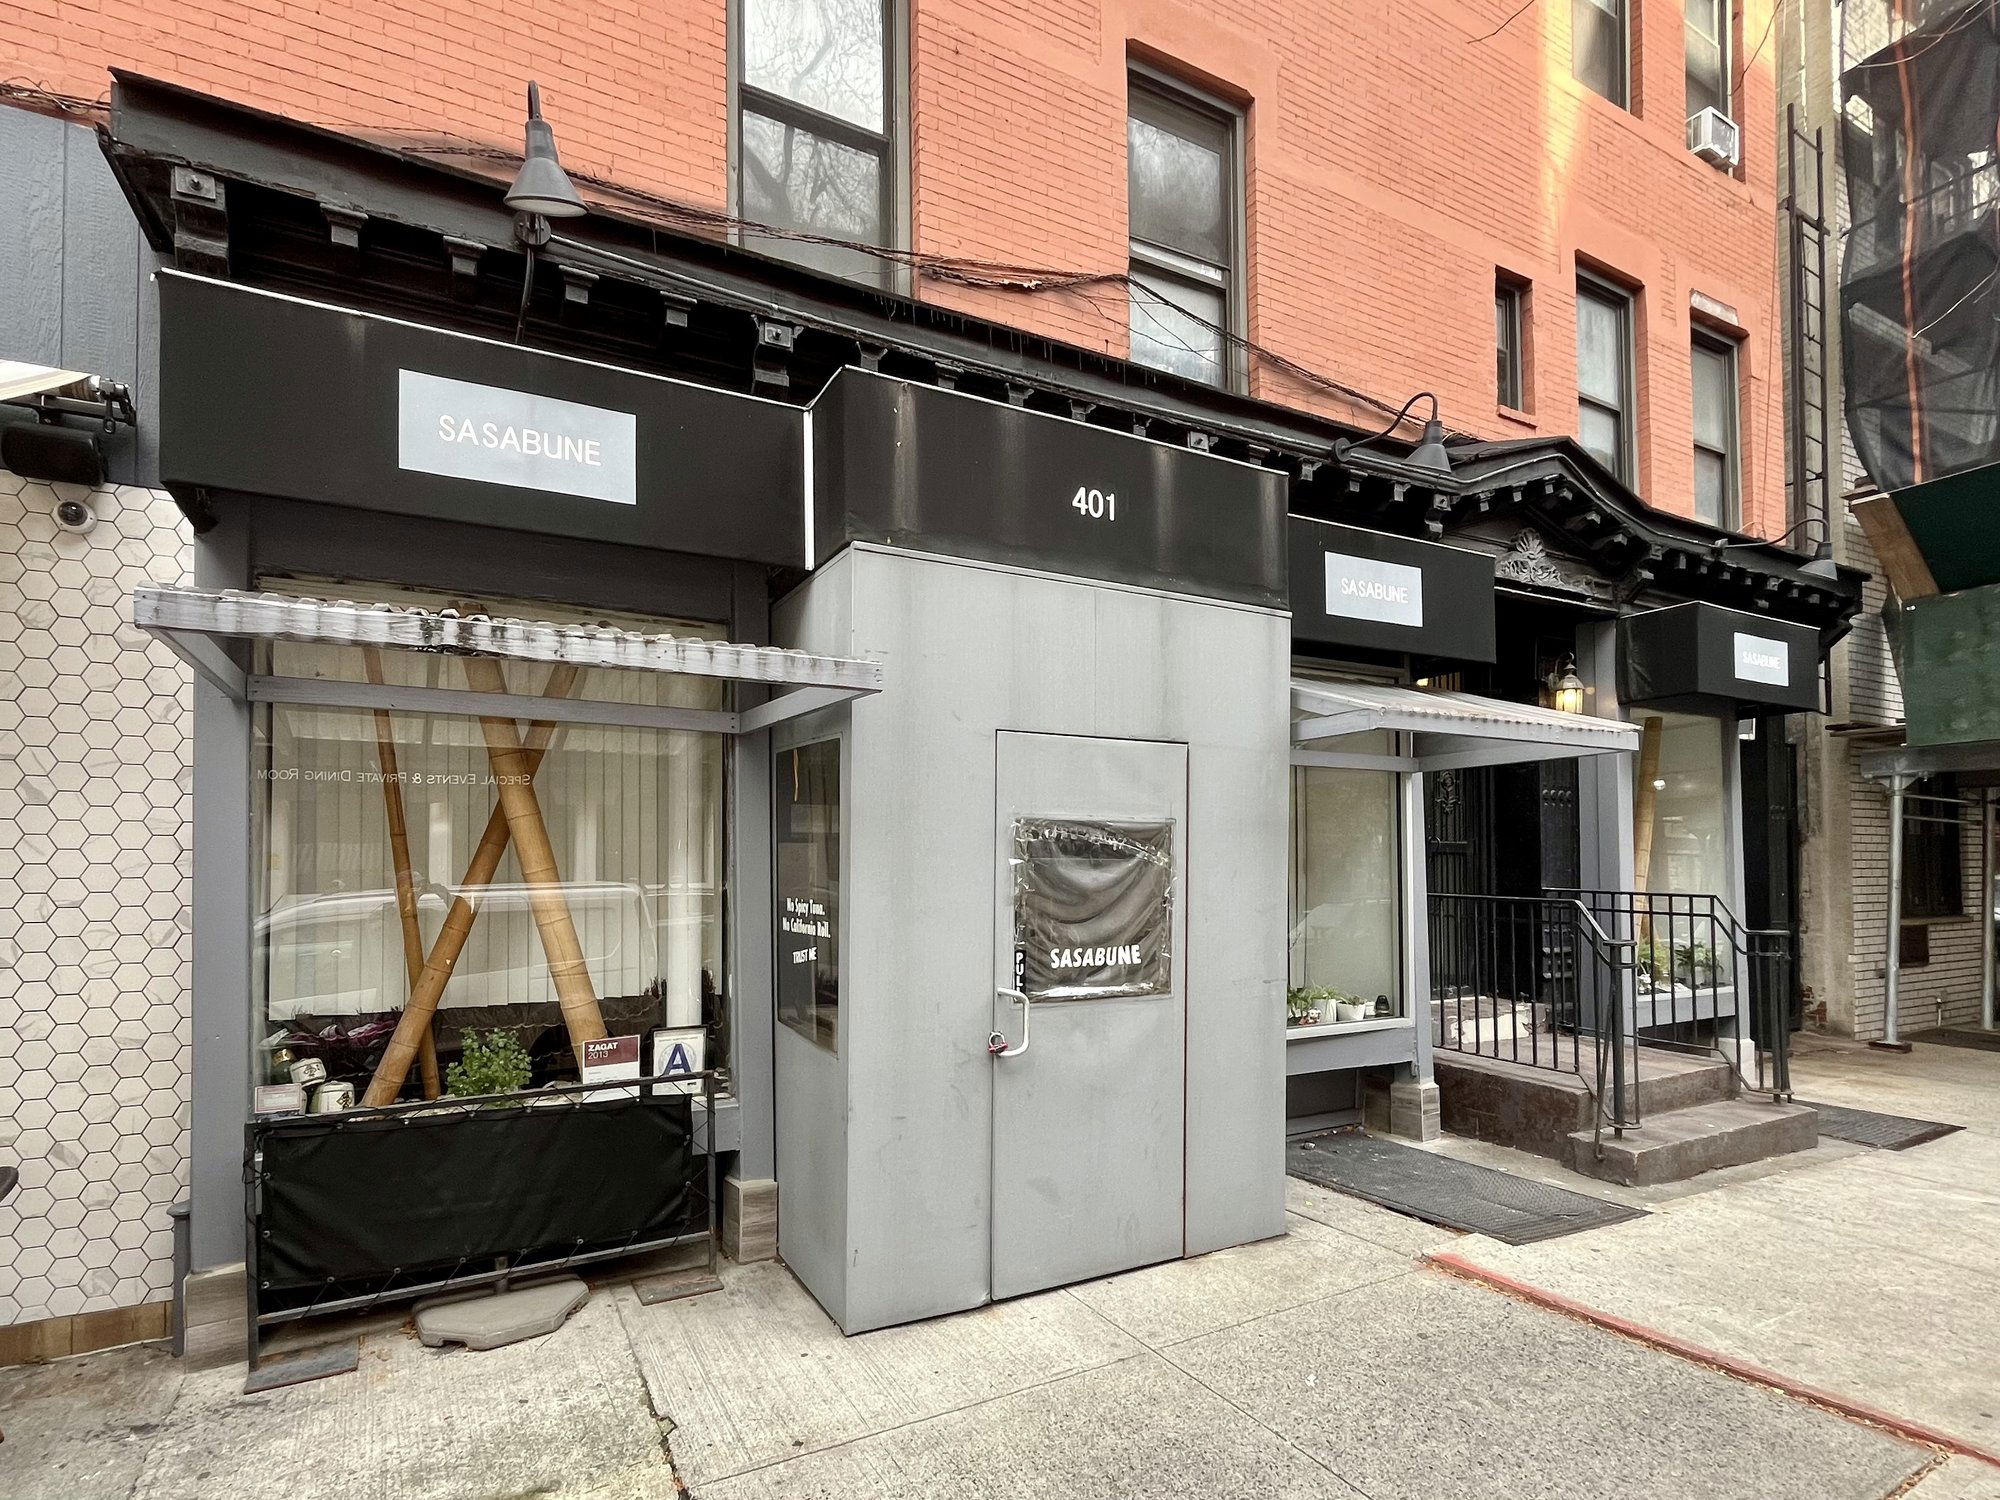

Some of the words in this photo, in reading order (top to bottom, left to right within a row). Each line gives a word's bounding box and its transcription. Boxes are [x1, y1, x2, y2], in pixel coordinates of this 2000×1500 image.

[438, 414, 601, 466] SASABUNE
[1072, 486, 1115, 521] 401
[1341, 577, 1409, 604] SASABUNE
[1742, 651, 1781, 670] SASABUNE
[786, 897, 795, 912] No
[795, 897, 809, 917] Spicy
[809, 899, 826, 916] Tuna.
[782, 916, 790, 931] No
[790, 917, 816, 936] California
[792, 949, 809, 964] TRUST
[808, 946, 818, 961] ME
[1049, 944, 1142, 969] SASABUNE
[587, 1041, 619, 1052] ZAGAT
[587, 1050, 609, 1060] 2013
[662, 1043, 692, 1076] A
